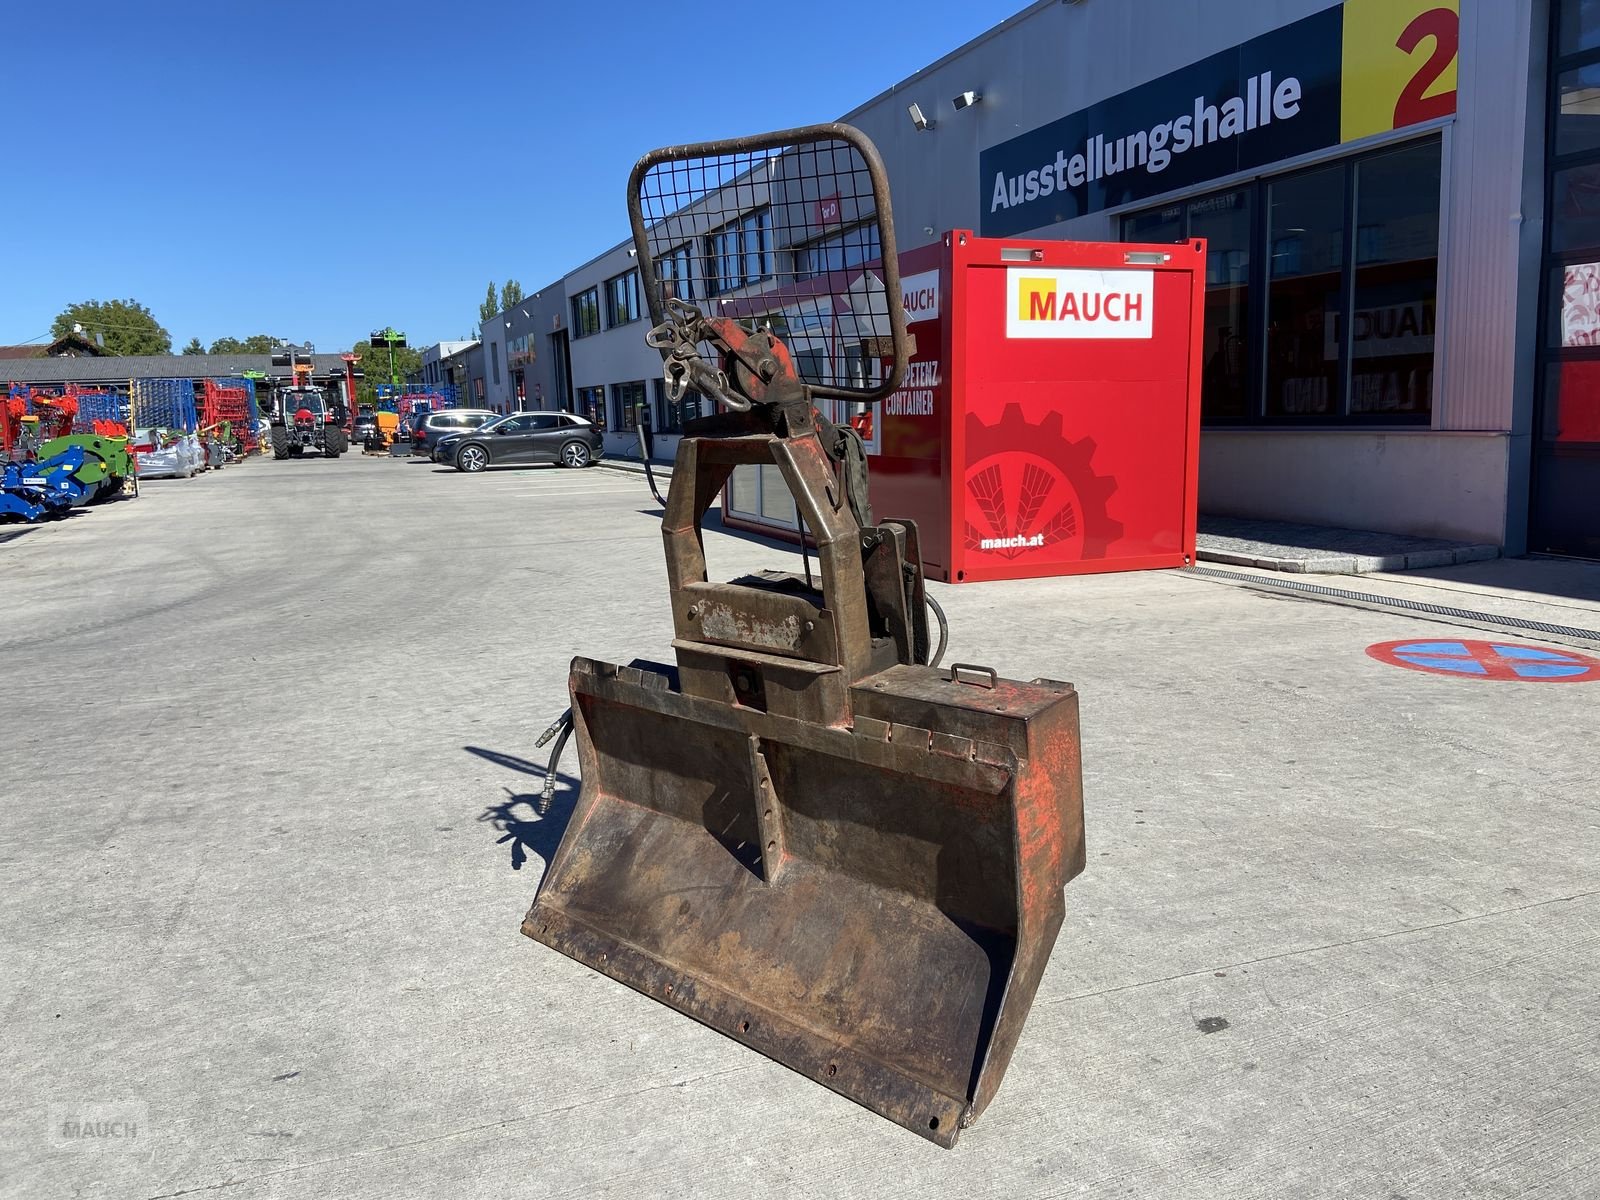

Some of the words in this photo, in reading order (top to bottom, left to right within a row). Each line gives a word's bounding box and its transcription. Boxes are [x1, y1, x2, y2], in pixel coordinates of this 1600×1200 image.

[990, 70, 1302, 213] Ausstellungshalle
[1392, 7, 1459, 130] 2
[903, 288, 935, 312] AUCH
[1030, 291, 1142, 322] MAUCH
[885, 361, 939, 388] KPETENZ
[885, 390, 933, 415] CONTAINER
[981, 533, 1044, 549] mauch.at
